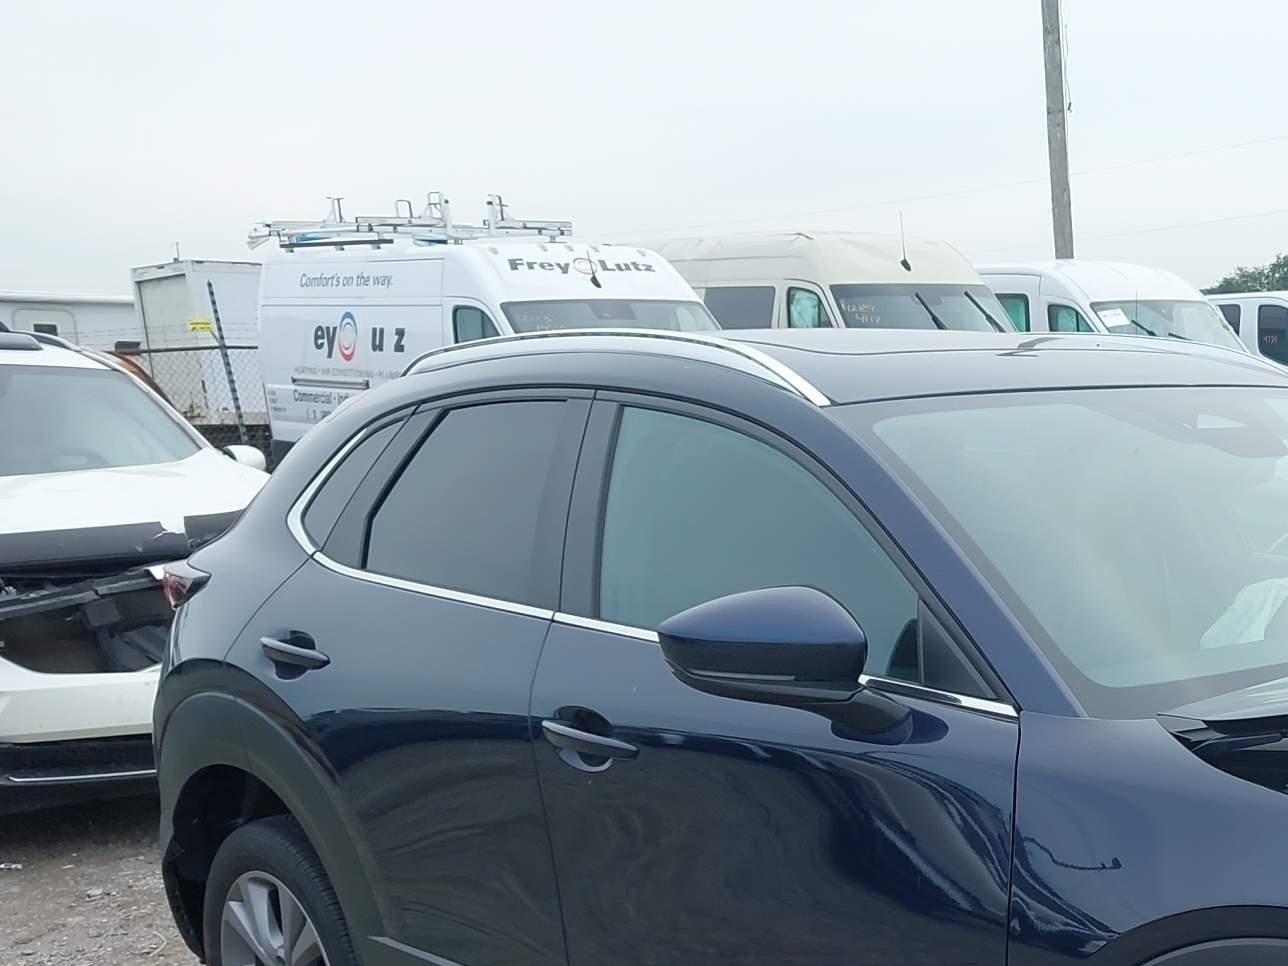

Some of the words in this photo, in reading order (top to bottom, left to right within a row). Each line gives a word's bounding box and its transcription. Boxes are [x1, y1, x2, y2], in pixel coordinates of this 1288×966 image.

[507, 258, 570, 275] Frey
[598, 259, 656, 273] Lutz
[299, 273, 341, 288] Comfort's
[343, 276, 354, 288] on
[356, 272, 371, 287] the
[373, 274, 395, 289] way.
[294, 389, 332, 404] Commercial
